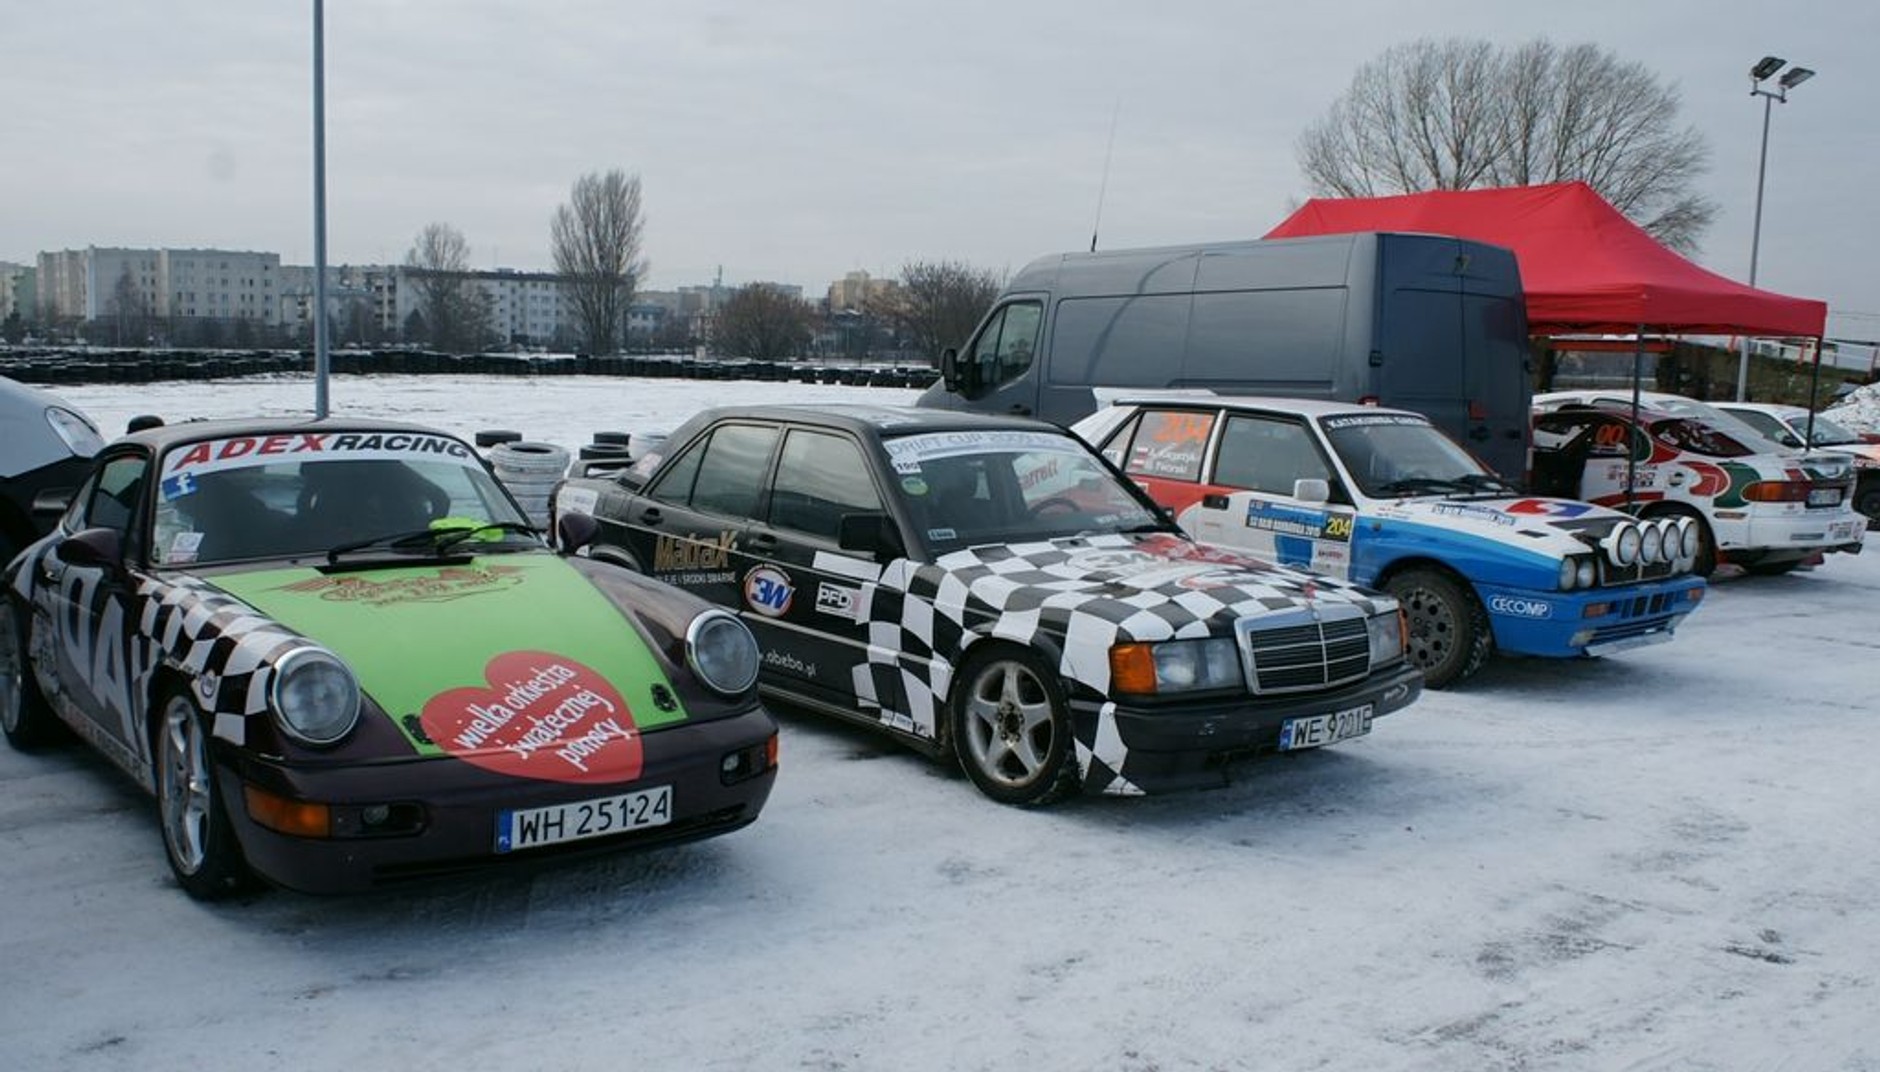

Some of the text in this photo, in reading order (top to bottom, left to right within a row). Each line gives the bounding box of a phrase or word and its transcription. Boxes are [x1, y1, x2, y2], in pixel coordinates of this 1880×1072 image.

[172, 433, 469, 471] ADEX RACING
[1326, 517, 1352, 536] 204
[750, 576, 792, 609] 3W
[1490, 597, 1549, 617] CECOMP
[453, 664, 577, 750] wielka orkiestra
[555, 717, 632, 772] pomocy
[1294, 718, 1323, 746] WE
[519, 807, 565, 844] WH
